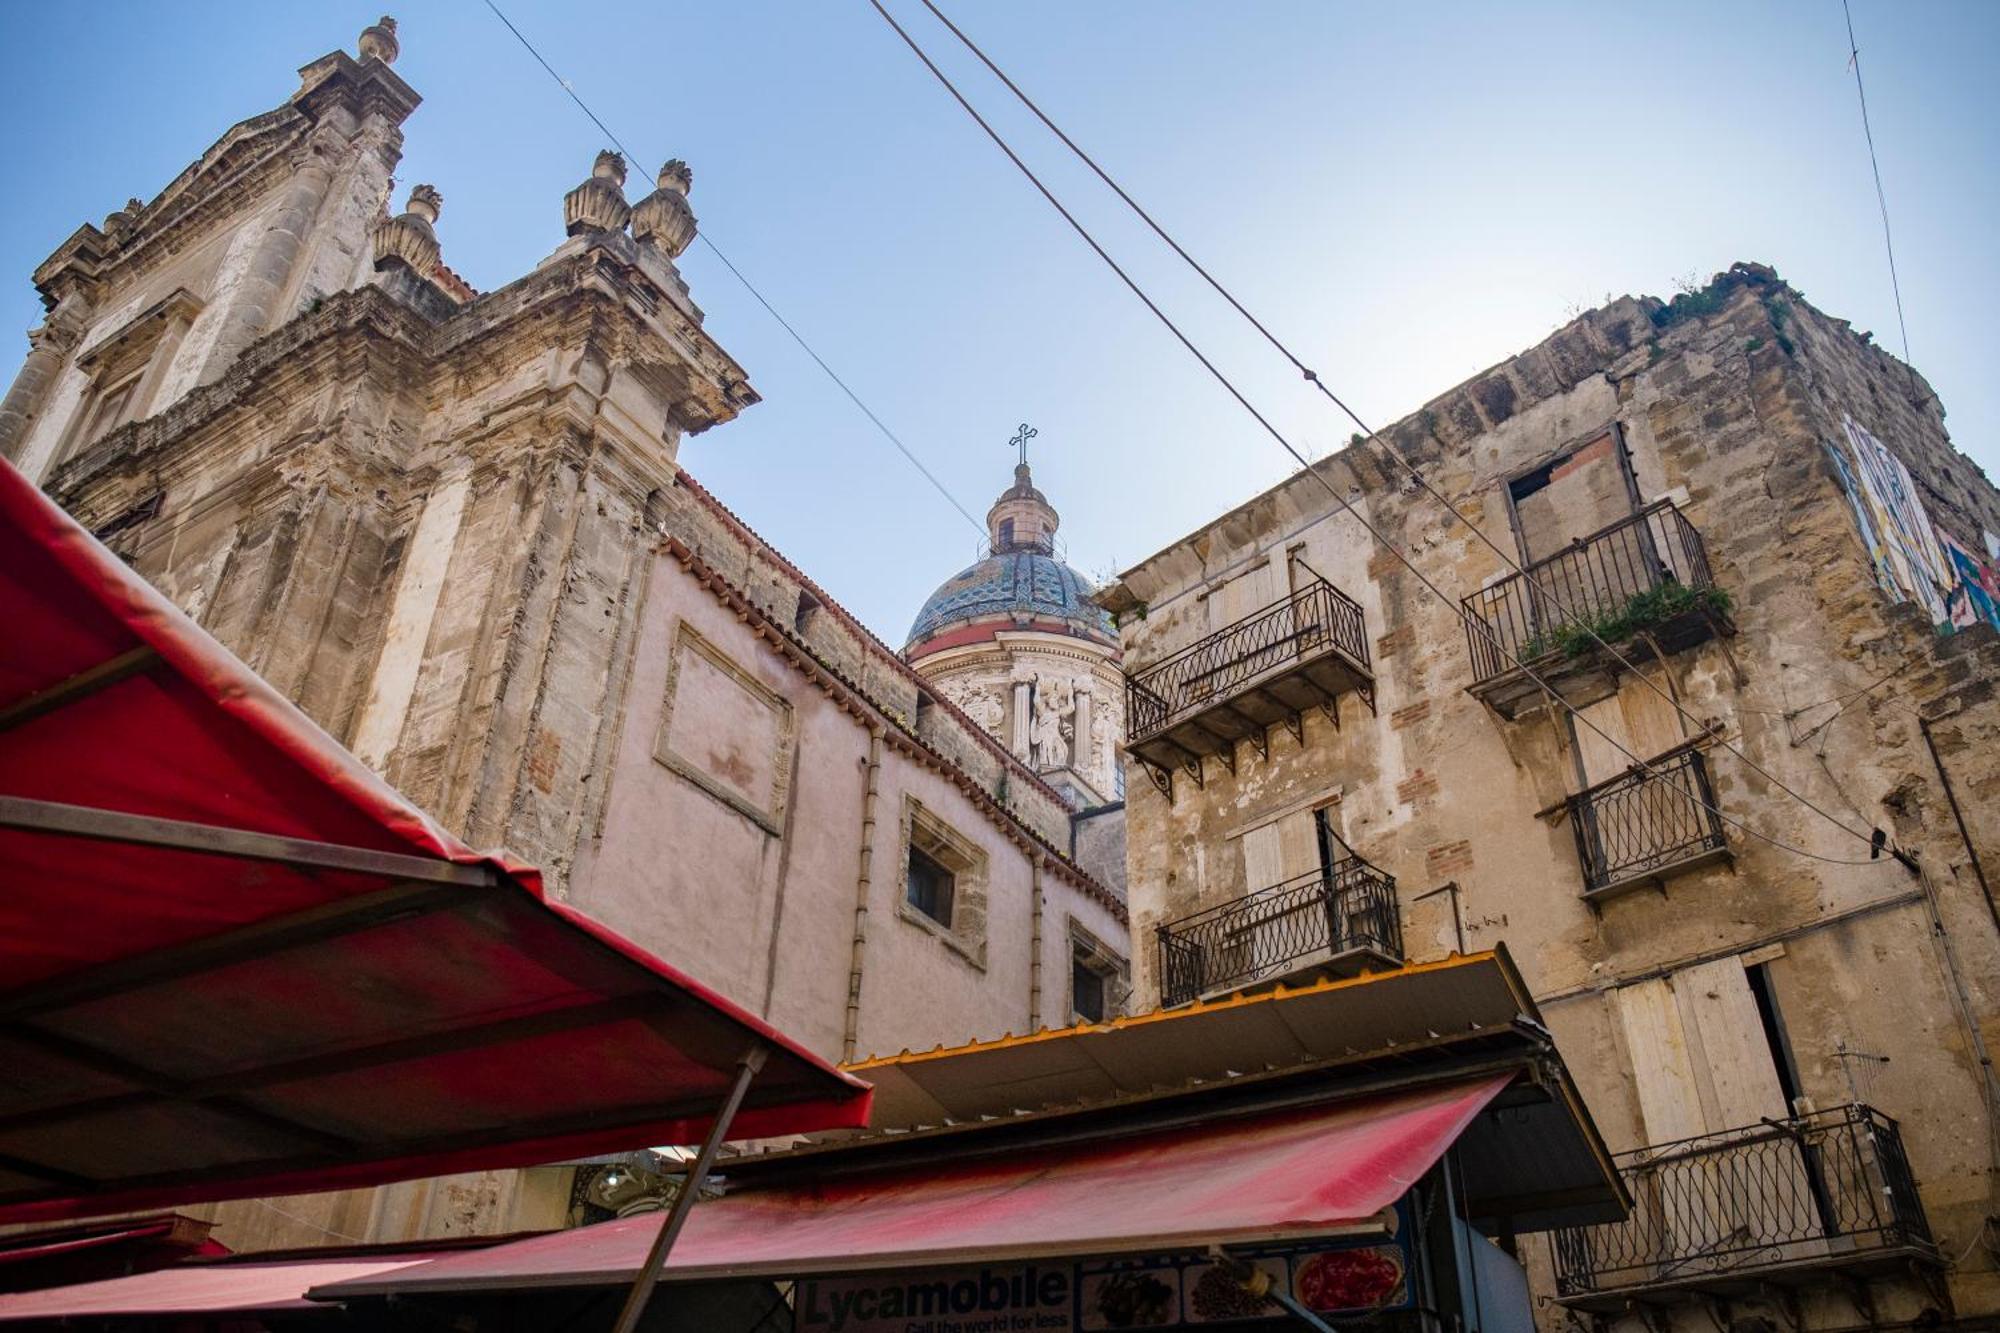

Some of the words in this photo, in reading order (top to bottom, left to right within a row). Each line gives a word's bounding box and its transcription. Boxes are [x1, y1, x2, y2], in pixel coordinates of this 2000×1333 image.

[805, 1267, 1067, 1330] Lycamobile
[905, 1320, 934, 1333] Call
[937, 1319, 962, 1333] the
[964, 1317, 1008, 1333] world
[1011, 1315, 1033, 1330] for
[1036, 1312, 1067, 1328] less
